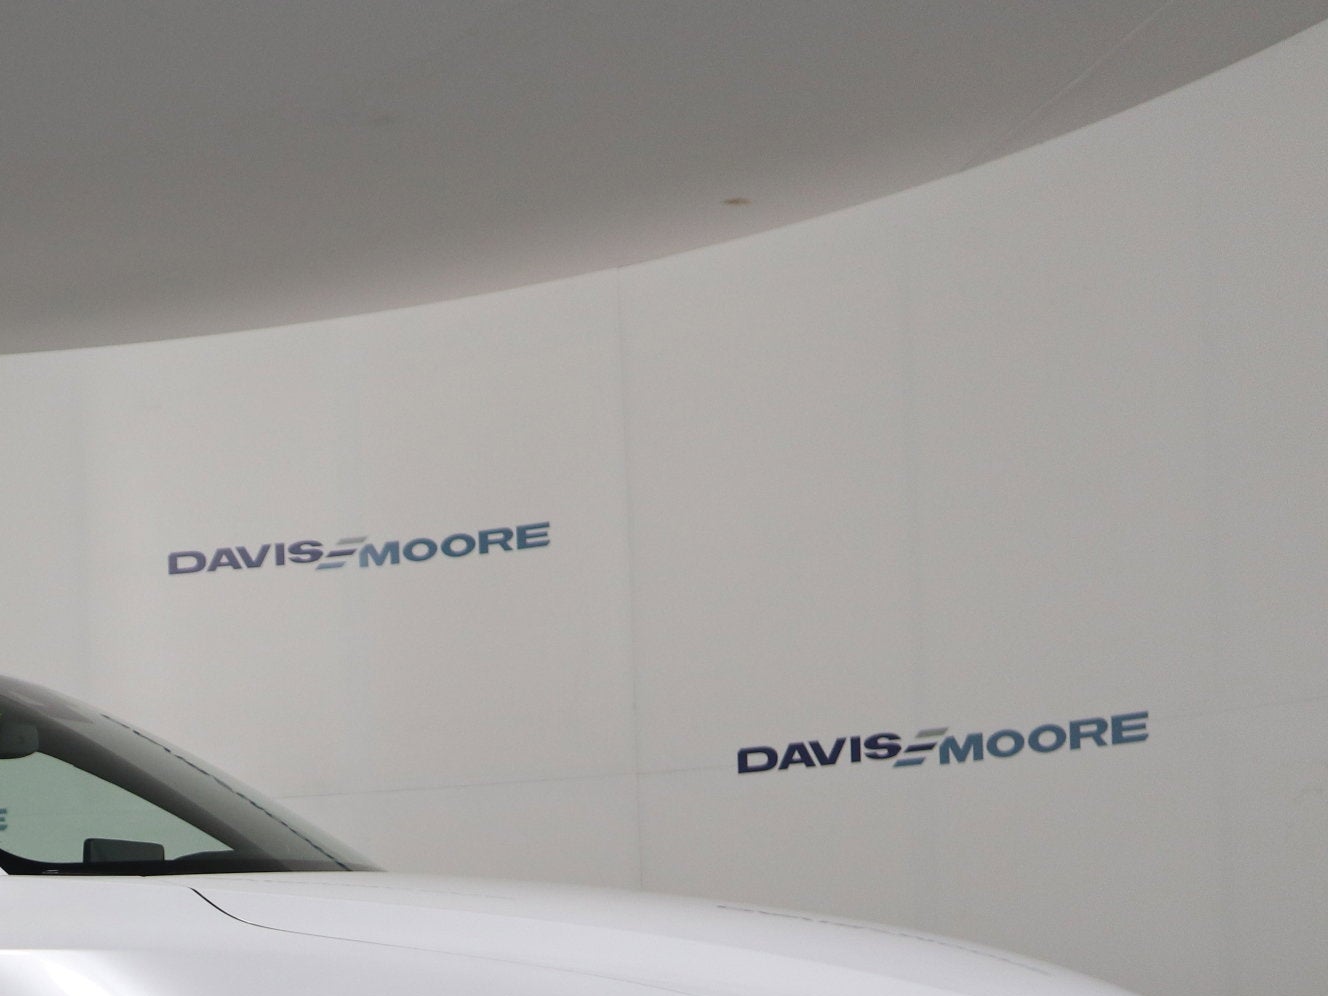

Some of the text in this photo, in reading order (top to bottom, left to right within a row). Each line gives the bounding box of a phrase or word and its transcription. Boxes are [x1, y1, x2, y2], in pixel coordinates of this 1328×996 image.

[168, 521, 550, 575] DAVIS MOORE
[737, 711, 1149, 774] DAVIS MOORE
